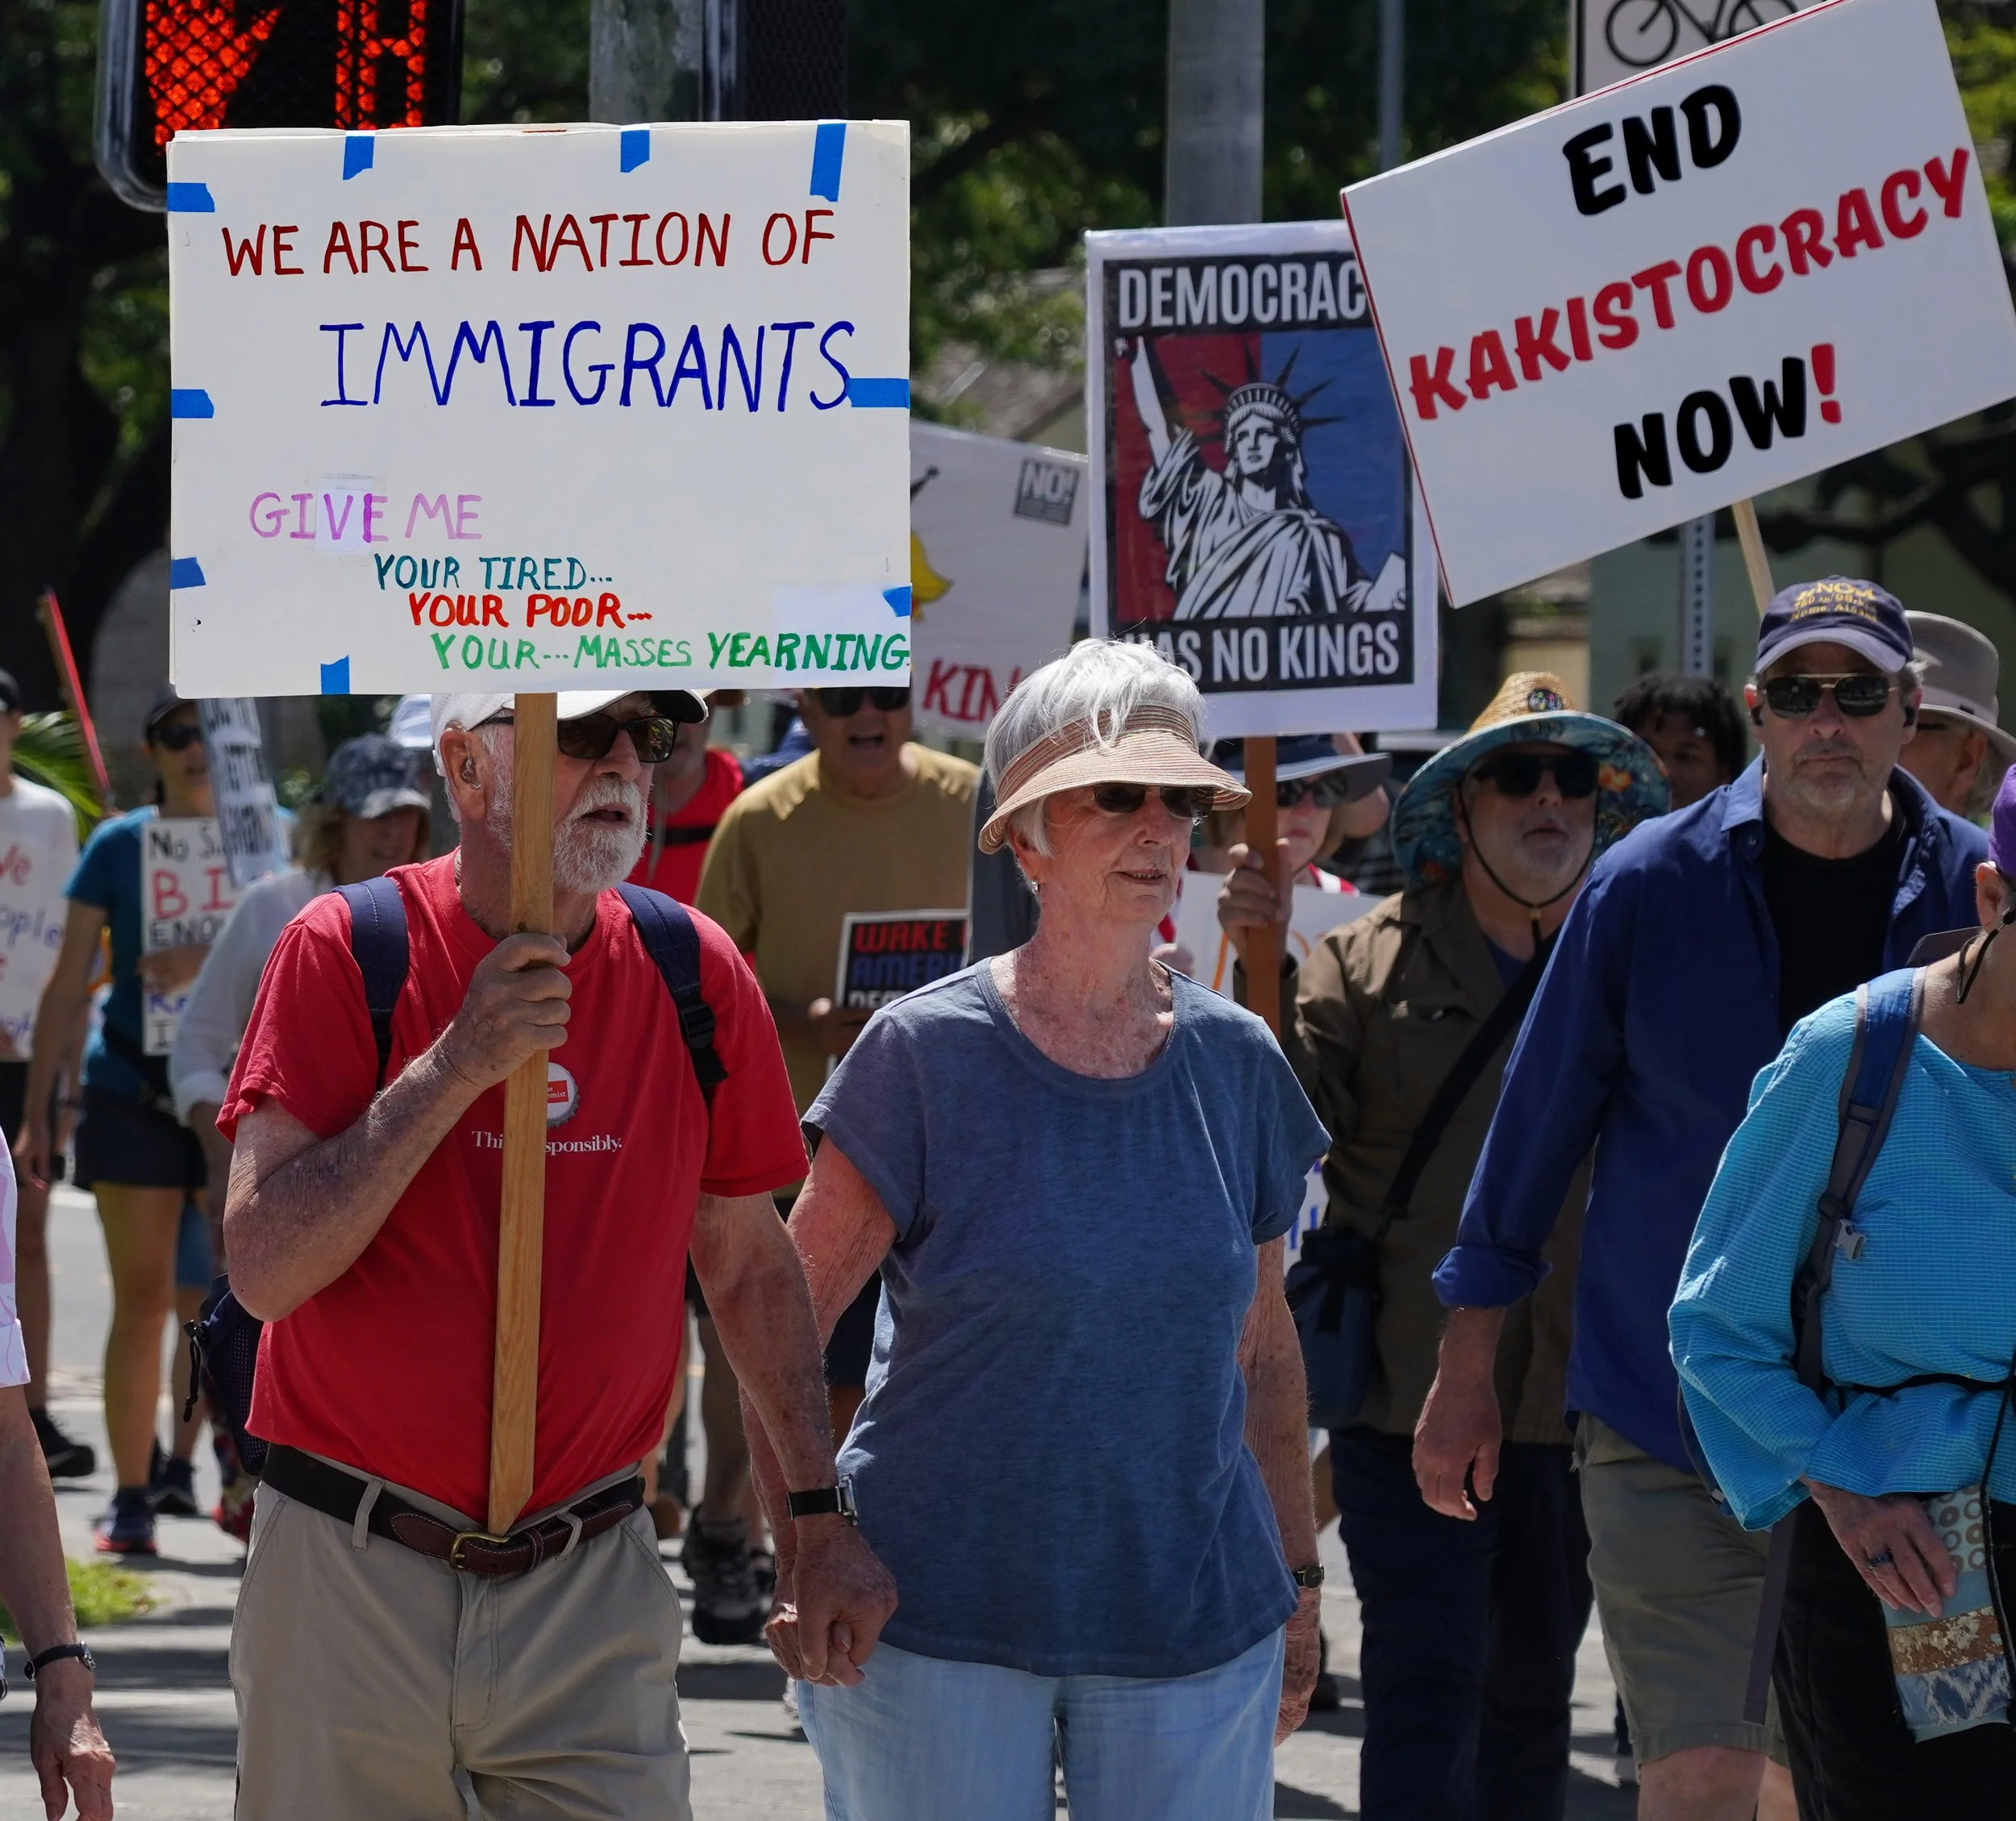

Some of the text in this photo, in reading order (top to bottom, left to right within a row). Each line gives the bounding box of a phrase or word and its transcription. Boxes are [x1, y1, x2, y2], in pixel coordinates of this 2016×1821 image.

[1562, 83, 1742, 216] END
[223, 210, 835, 277] WE ARE A NATION OF
[1118, 260, 1366, 328] DEMOCRAC
[1409, 148, 1969, 421] KAKISTOCRACY
[319, 320, 855, 412] IMMIGRANTS
[1614, 342, 1843, 499] NOW!
[248, 492, 483, 543] GIVE ME
[374, 553, 612, 590] YOUR TIRED...
[409, 592, 653, 629] YOUR POOR...
[1123, 621, 1401, 683] AS NO KINGS
[149, 827, 190, 864] No
[151, 868, 235, 921] BI
[854, 920, 950, 953] WAKE
[472, 1131, 623, 1156] Thi sponsibly.
